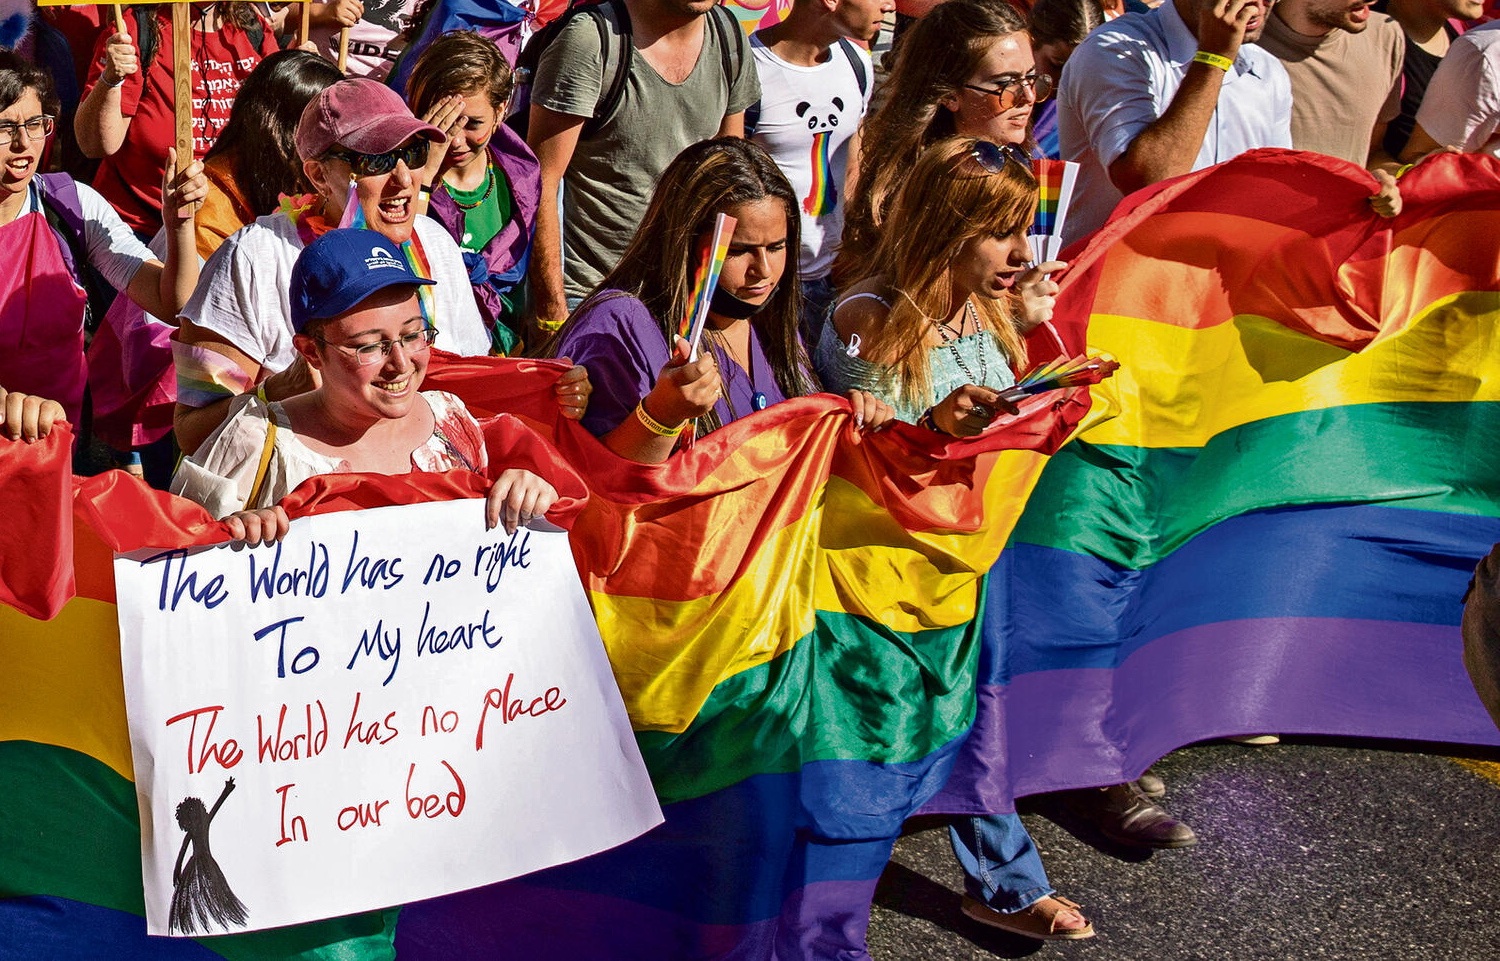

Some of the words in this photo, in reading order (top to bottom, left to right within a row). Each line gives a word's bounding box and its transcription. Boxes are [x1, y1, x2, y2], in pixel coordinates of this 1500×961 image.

[141, 548, 229, 613] The
[249, 540, 328, 603] World
[340, 529, 404, 595] has
[423, 552, 461, 585] no
[473, 530, 532, 594] right
[253, 616, 321, 679] To
[346, 618, 402, 687] My
[417, 601, 503, 658] heart
[165, 705, 244, 775] The
[256, 699, 328, 764] World
[343, 692, 399, 749] has
[421, 705, 459, 736] no
[475, 673, 569, 751] place
[275, 783, 309, 847] In
[337, 798, 390, 831] our
[405, 759, 466, 819] bed
